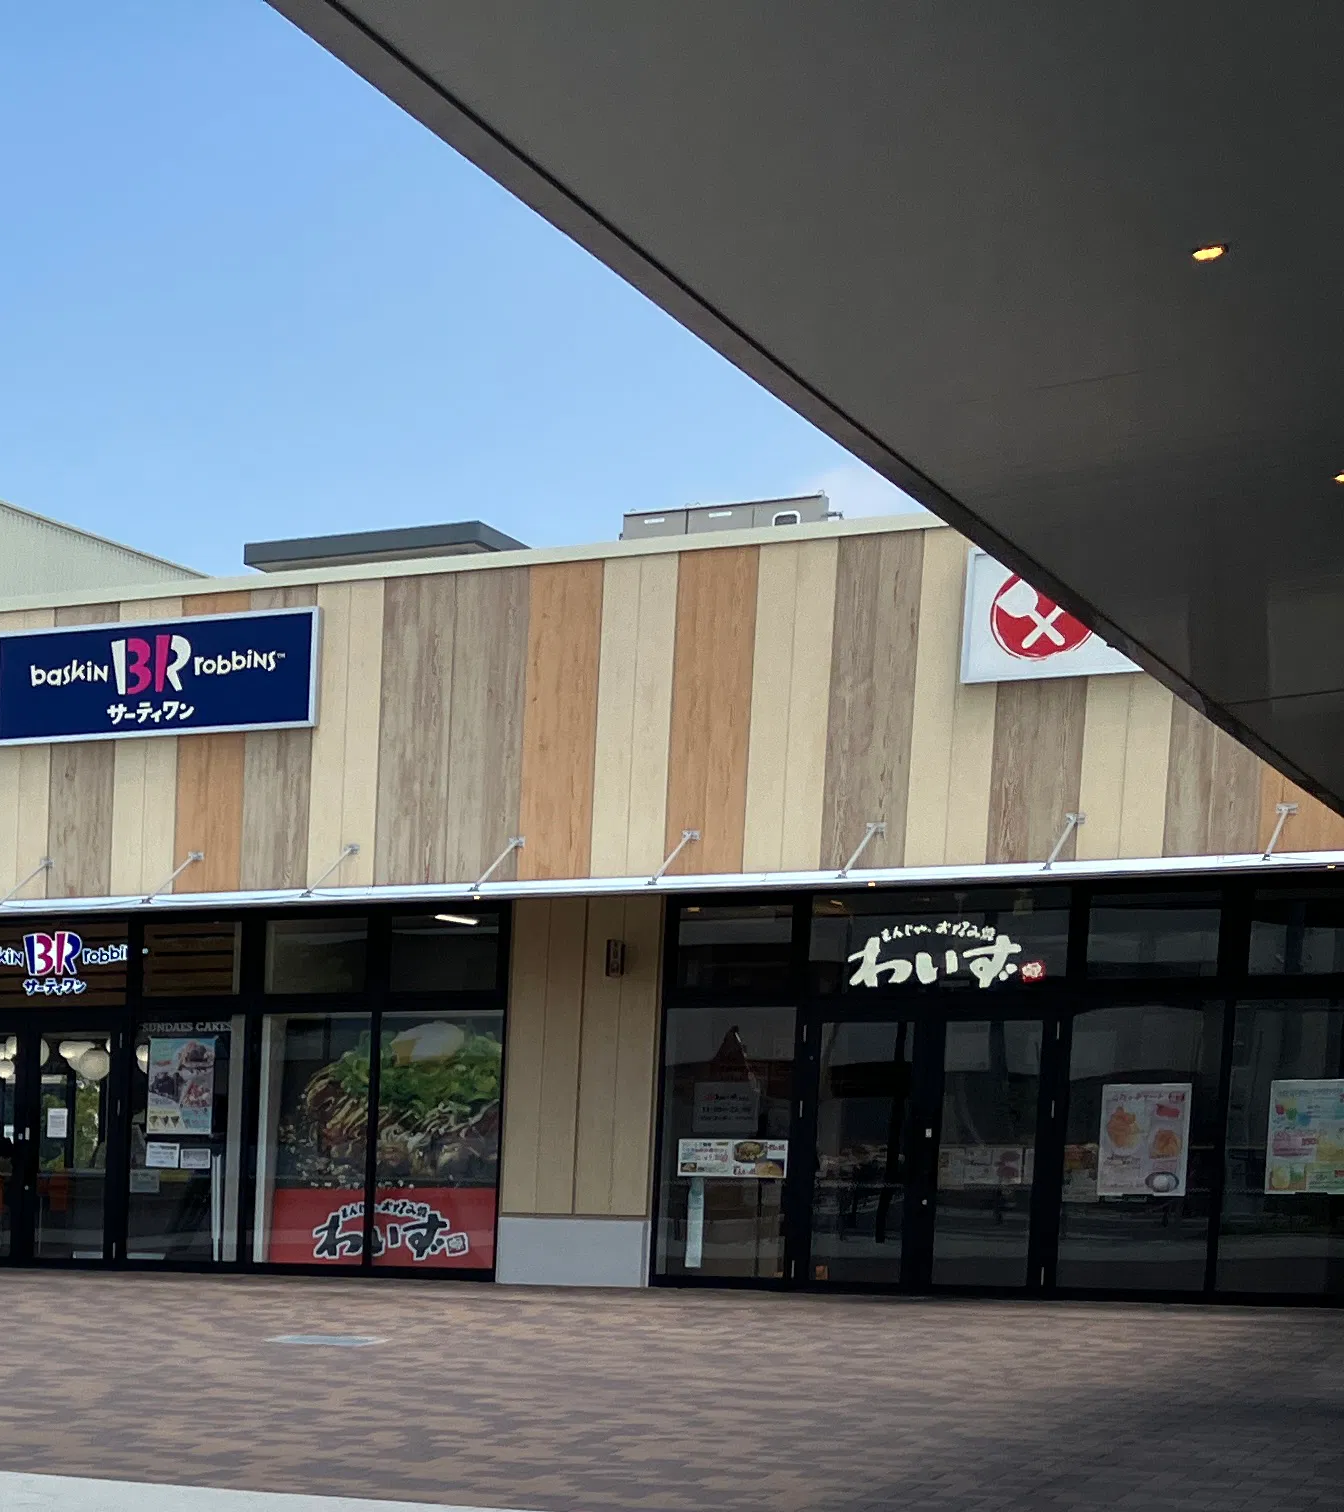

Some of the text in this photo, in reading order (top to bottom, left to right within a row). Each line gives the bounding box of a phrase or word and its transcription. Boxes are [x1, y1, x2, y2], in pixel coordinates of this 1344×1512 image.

[30, 659, 109, 688] baskin
[111, 634, 192, 696] BR
[106, 699, 195, 725] サーティワン
[23, 931, 82, 976] BR
[847, 935, 1023, 988] わいず
[23, 978, 87, 997] サーティワン
[142, 1022, 232, 1032] SUNDAES CAKES
